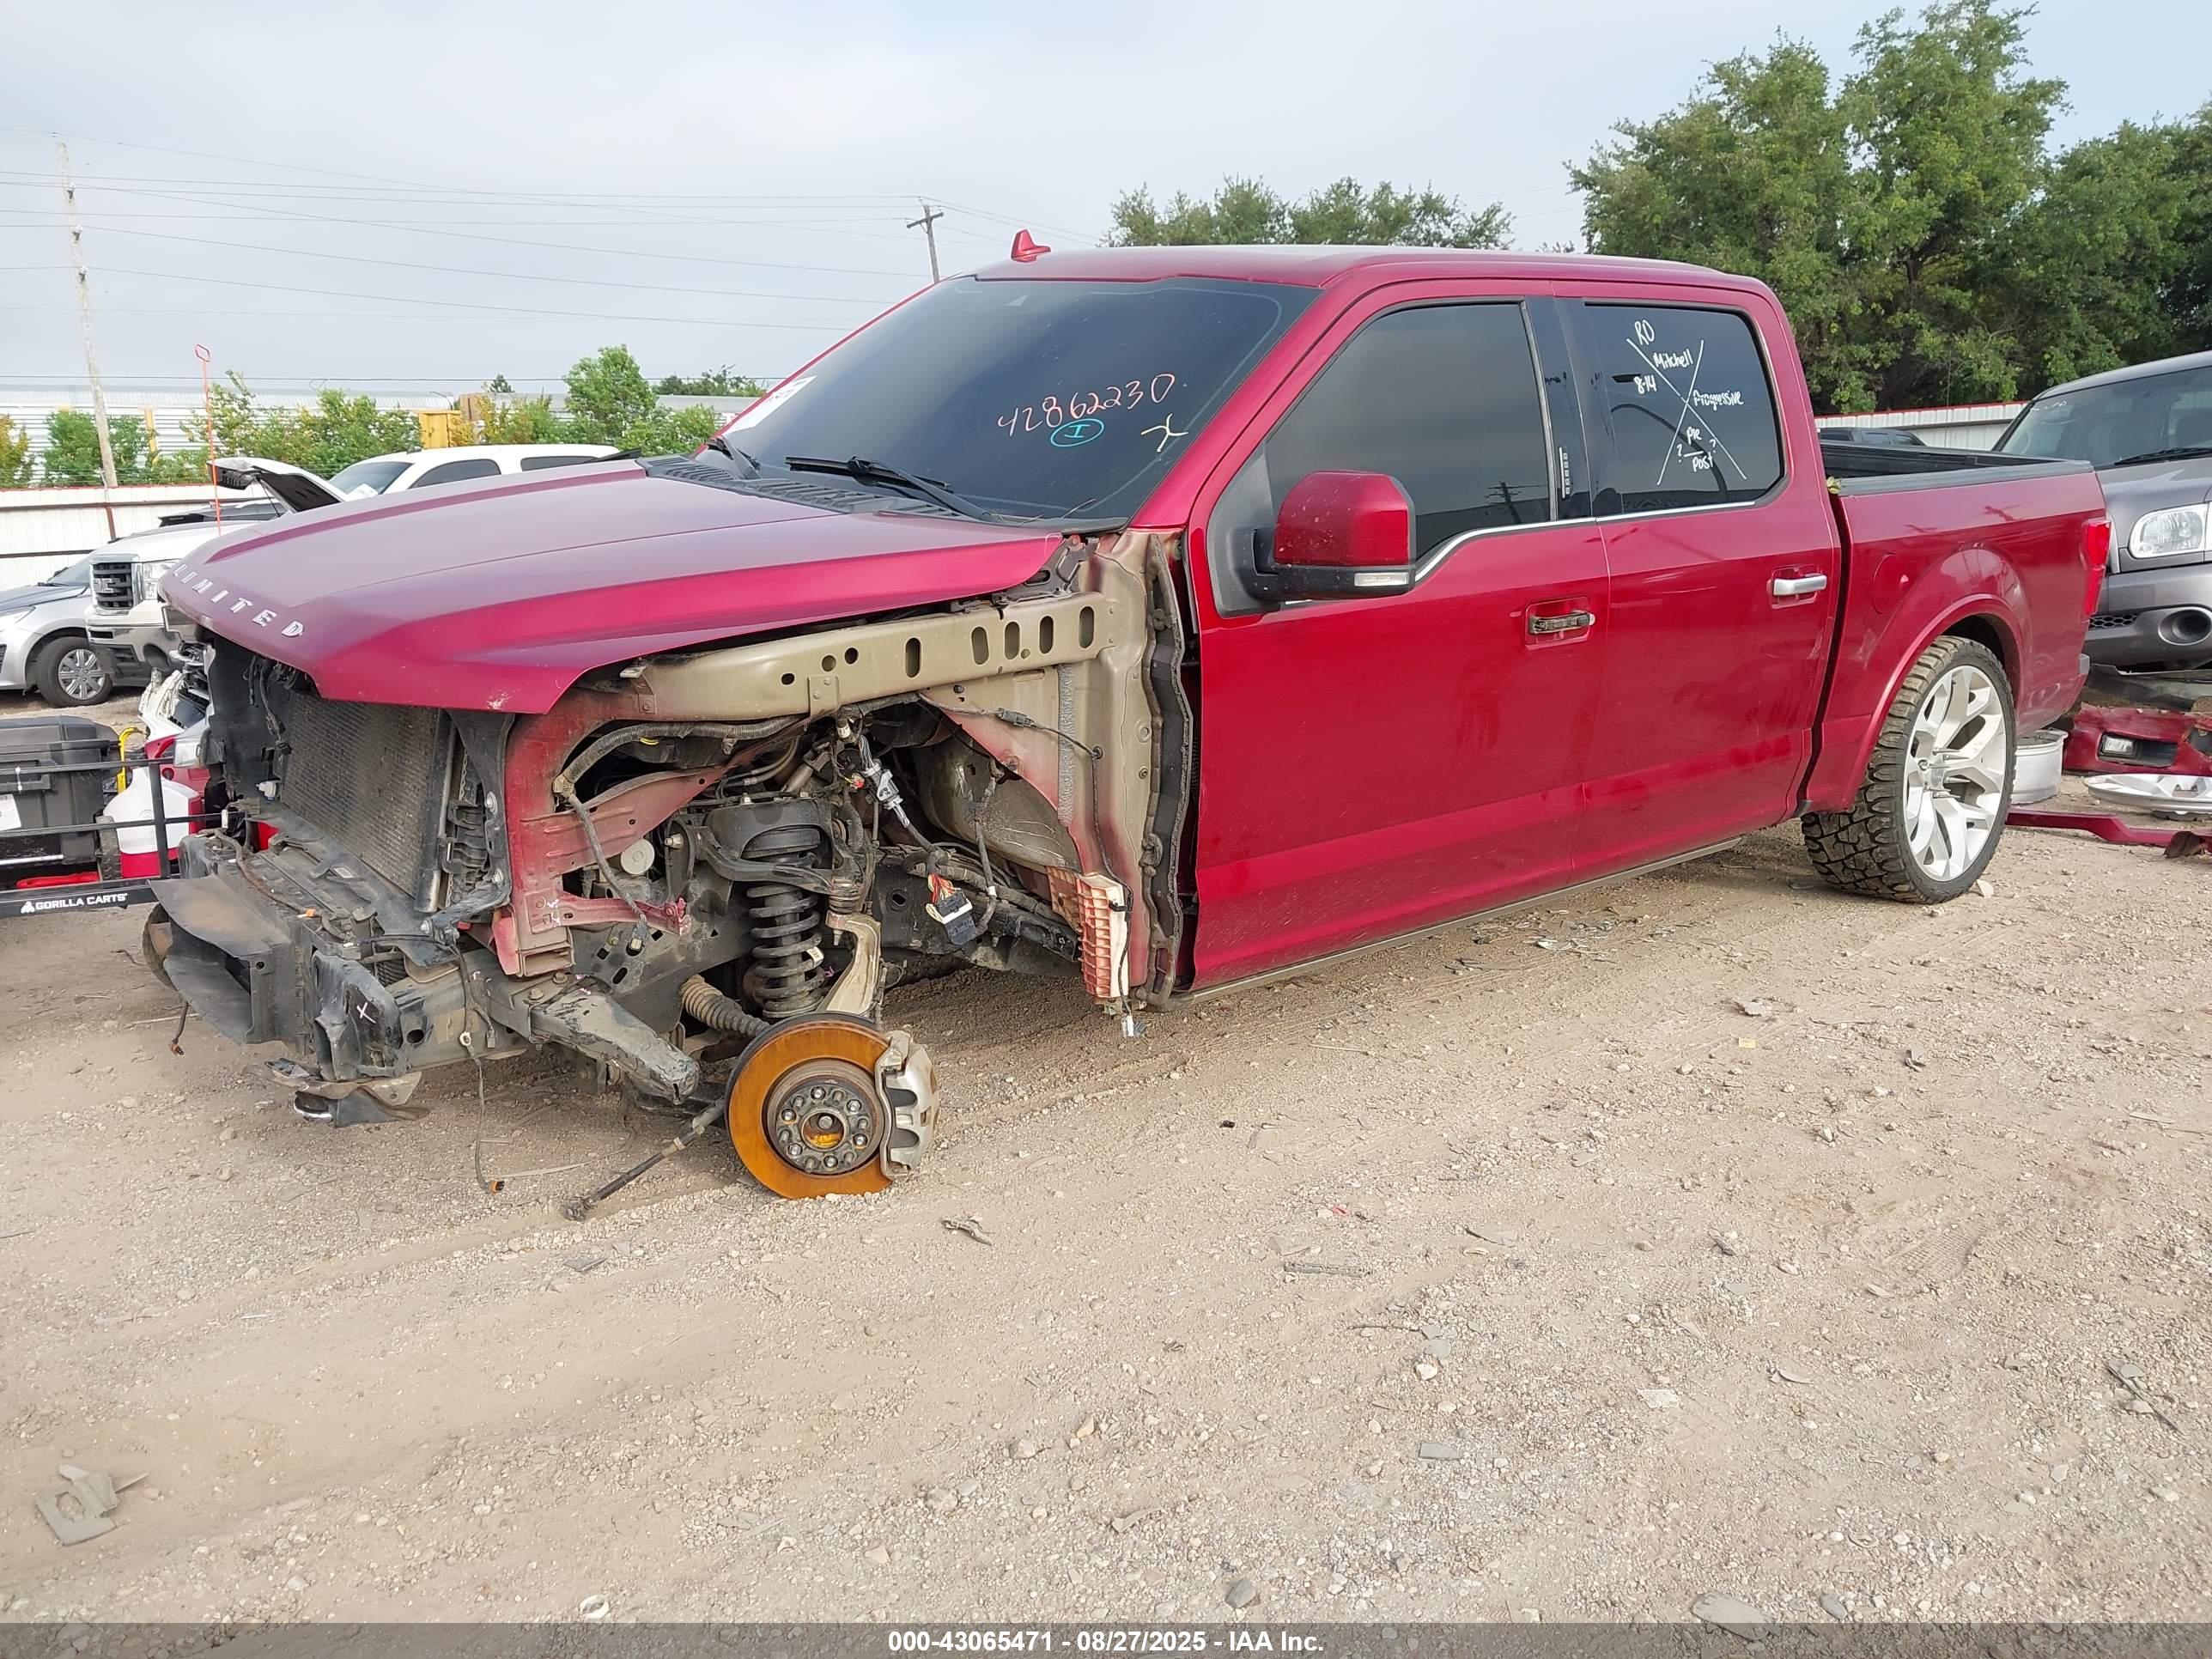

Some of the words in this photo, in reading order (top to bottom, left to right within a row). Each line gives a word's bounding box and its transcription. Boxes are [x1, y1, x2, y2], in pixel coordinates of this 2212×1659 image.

[1653, 348, 1694, 369] Mitchell
[1693, 389, 1744, 411] Progressive
[173, 563, 305, 637] LIMITED
[35, 898, 84, 910] GORILLA
[86, 894, 126, 905] CARTS
